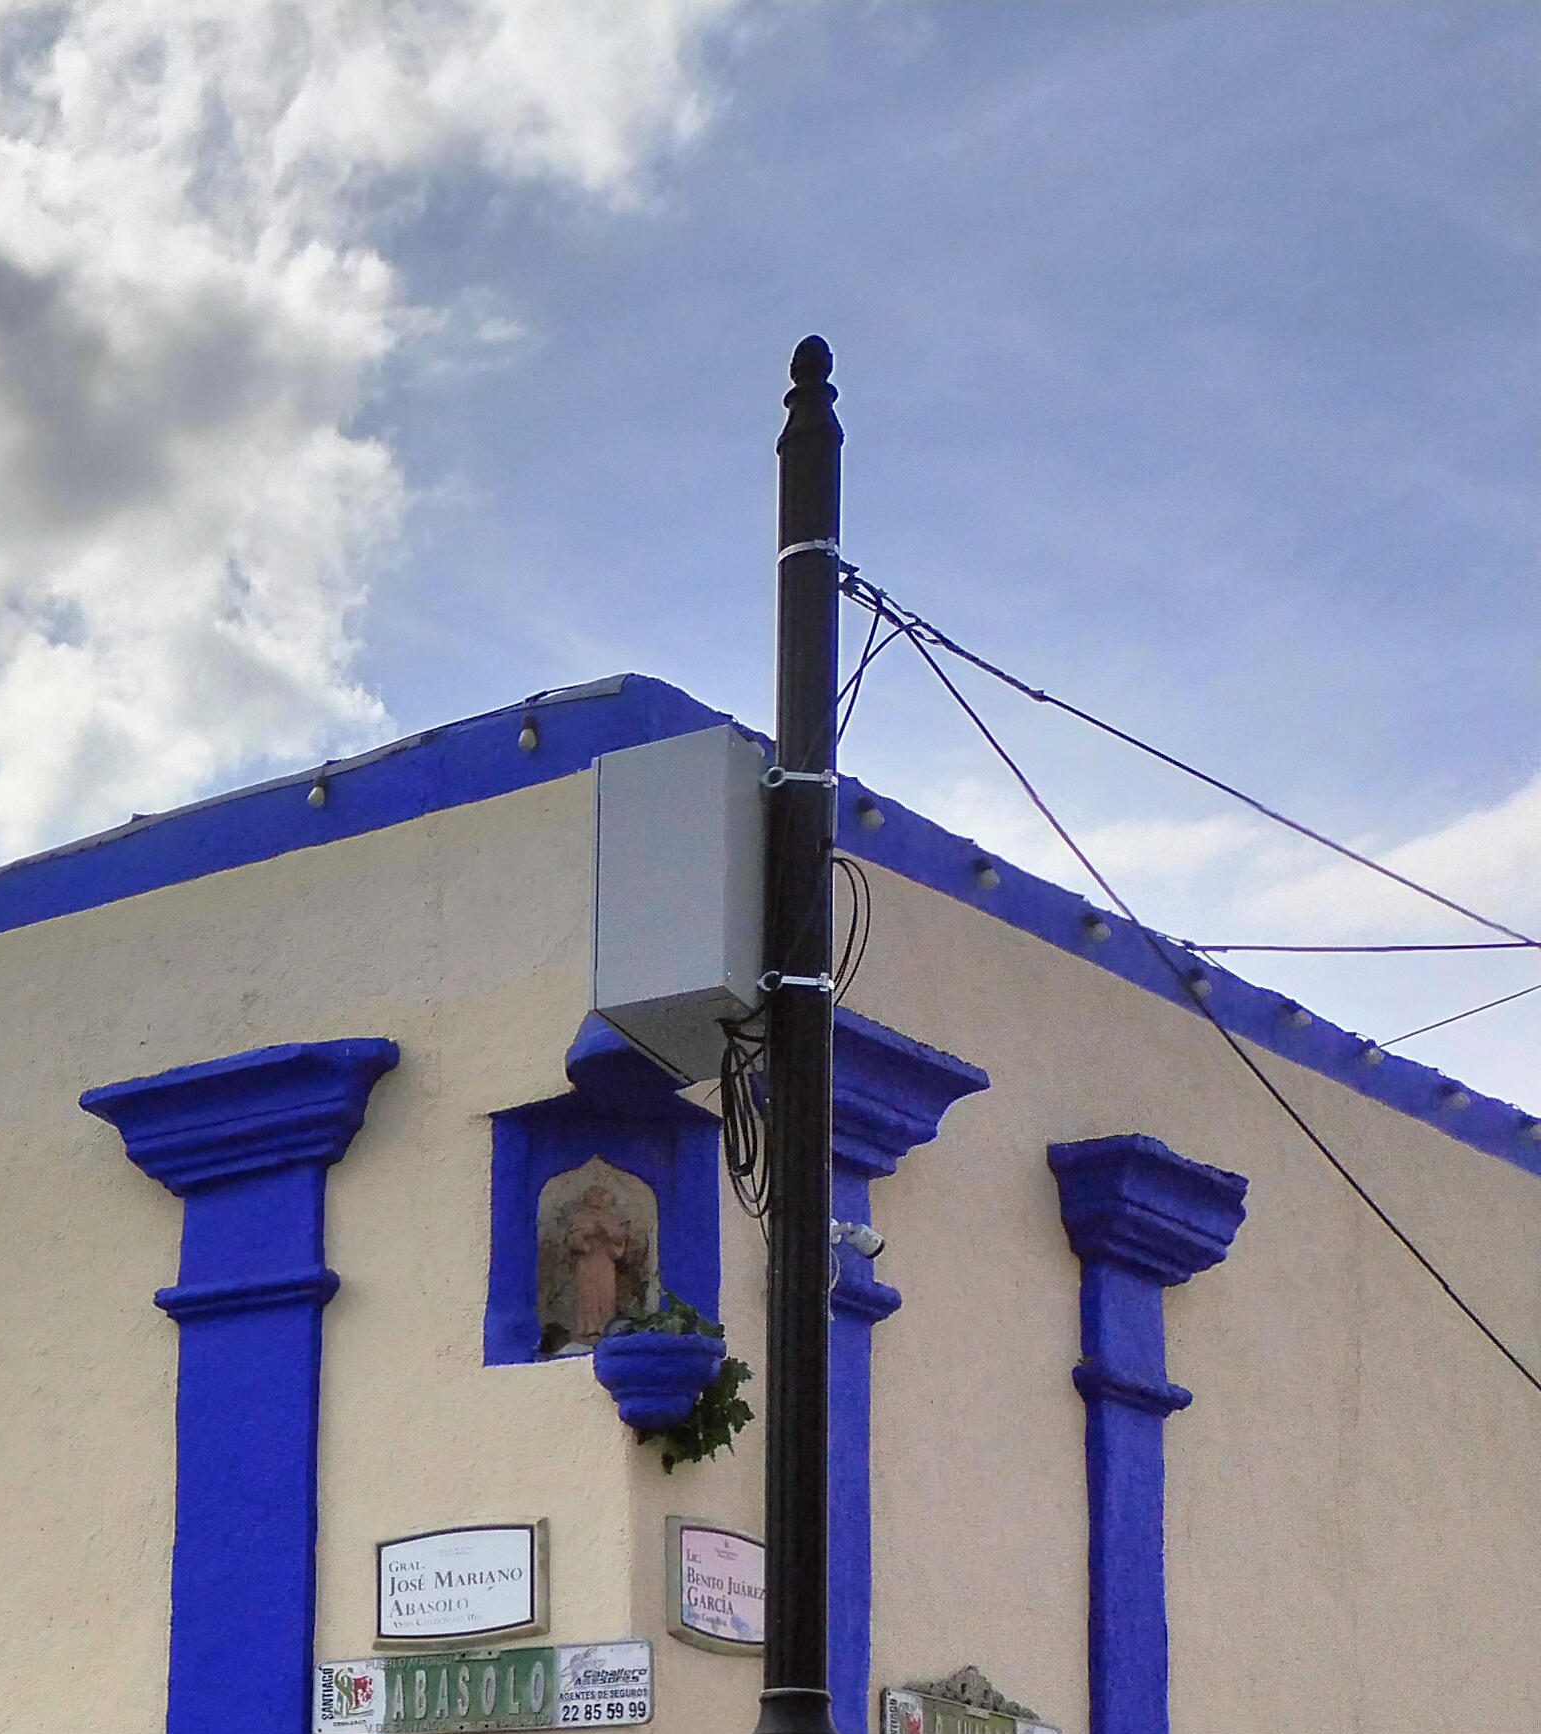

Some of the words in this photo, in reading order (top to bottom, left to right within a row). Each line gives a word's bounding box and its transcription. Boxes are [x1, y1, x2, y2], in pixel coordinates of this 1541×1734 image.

[388, 1573, 427, 1597] JOSÉ
[434, 1567, 523, 1590] MARIANO
[687, 1565, 724, 1591] BENITO
[727, 1576, 767, 1601] JUÁREZ
[389, 1597, 469, 1618] ABASOLO
[687, 1585, 734, 1616] GARCÍA
[583, 1667, 648, 1678] Caballero
[321, 1667, 335, 1721] SANTIAGO
[393, 1660, 546, 1721] ABASOLO
[558, 1690, 596, 1701] AGENTES
[597, 1690, 608, 1699] DE
[562, 1704, 579, 1721] 22
[584, 1703, 602, 1721] 85
[606, 1702, 624, 1719] 59
[628, 1701, 646, 1718] 99
